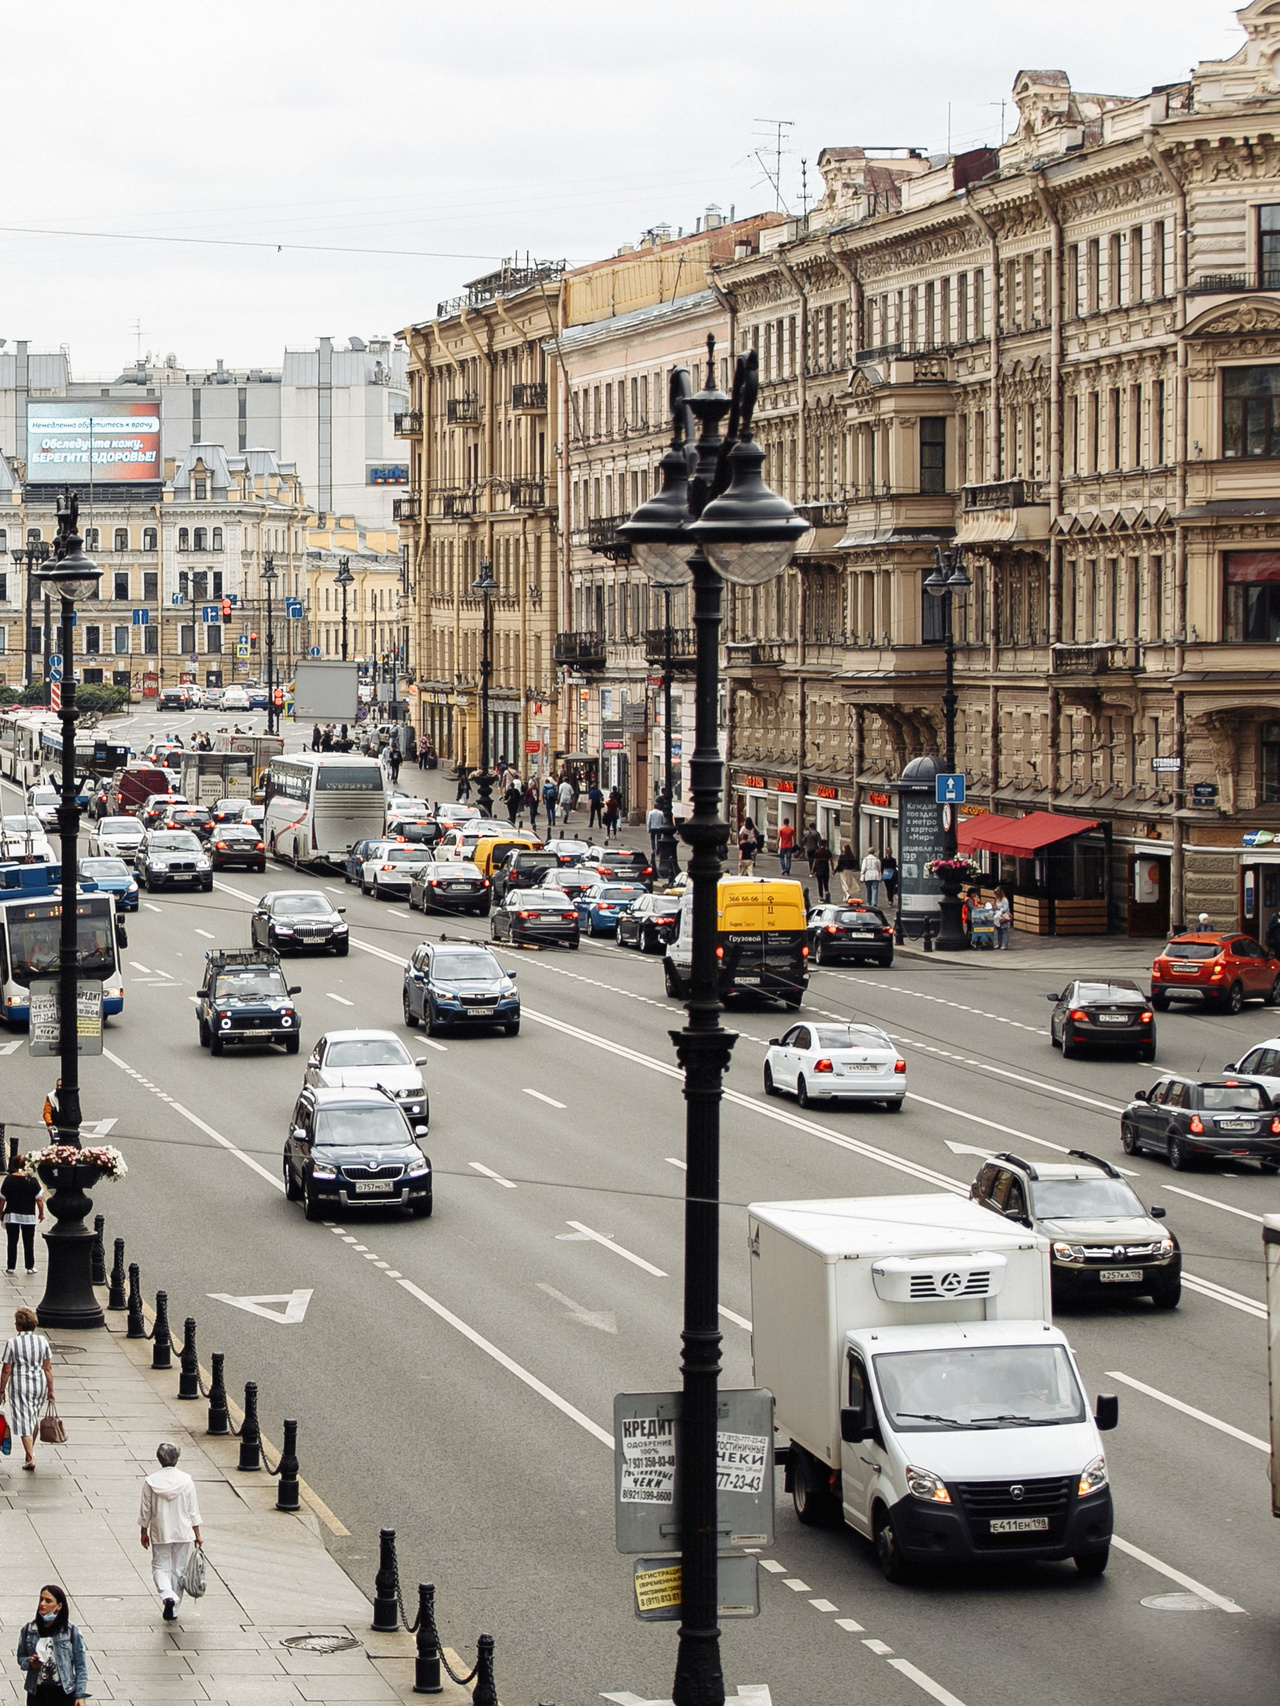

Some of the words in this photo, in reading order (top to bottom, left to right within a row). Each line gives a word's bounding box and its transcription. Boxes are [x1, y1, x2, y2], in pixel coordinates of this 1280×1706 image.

[131, 421, 153, 429] врачу
[42, 438, 110, 451] Обследуйте
[31, 451, 90, 464] БЕРЕГИТЕ
[91, 450, 157, 465] ЗДОРОВЬЕ!
[906, 811, 938, 819] поездка
[911, 826, 939, 834] картой
[728, 935, 762, 943] Грузовой
[623, 1419, 674, 1439] КРЕДИТ
[626, 1440, 673, 1449] ОДОБРЕНИЕ
[633, 1477, 664, 1489] ЧЕКИ
[992, 1520, 1031, 1532] Е411ЕН
